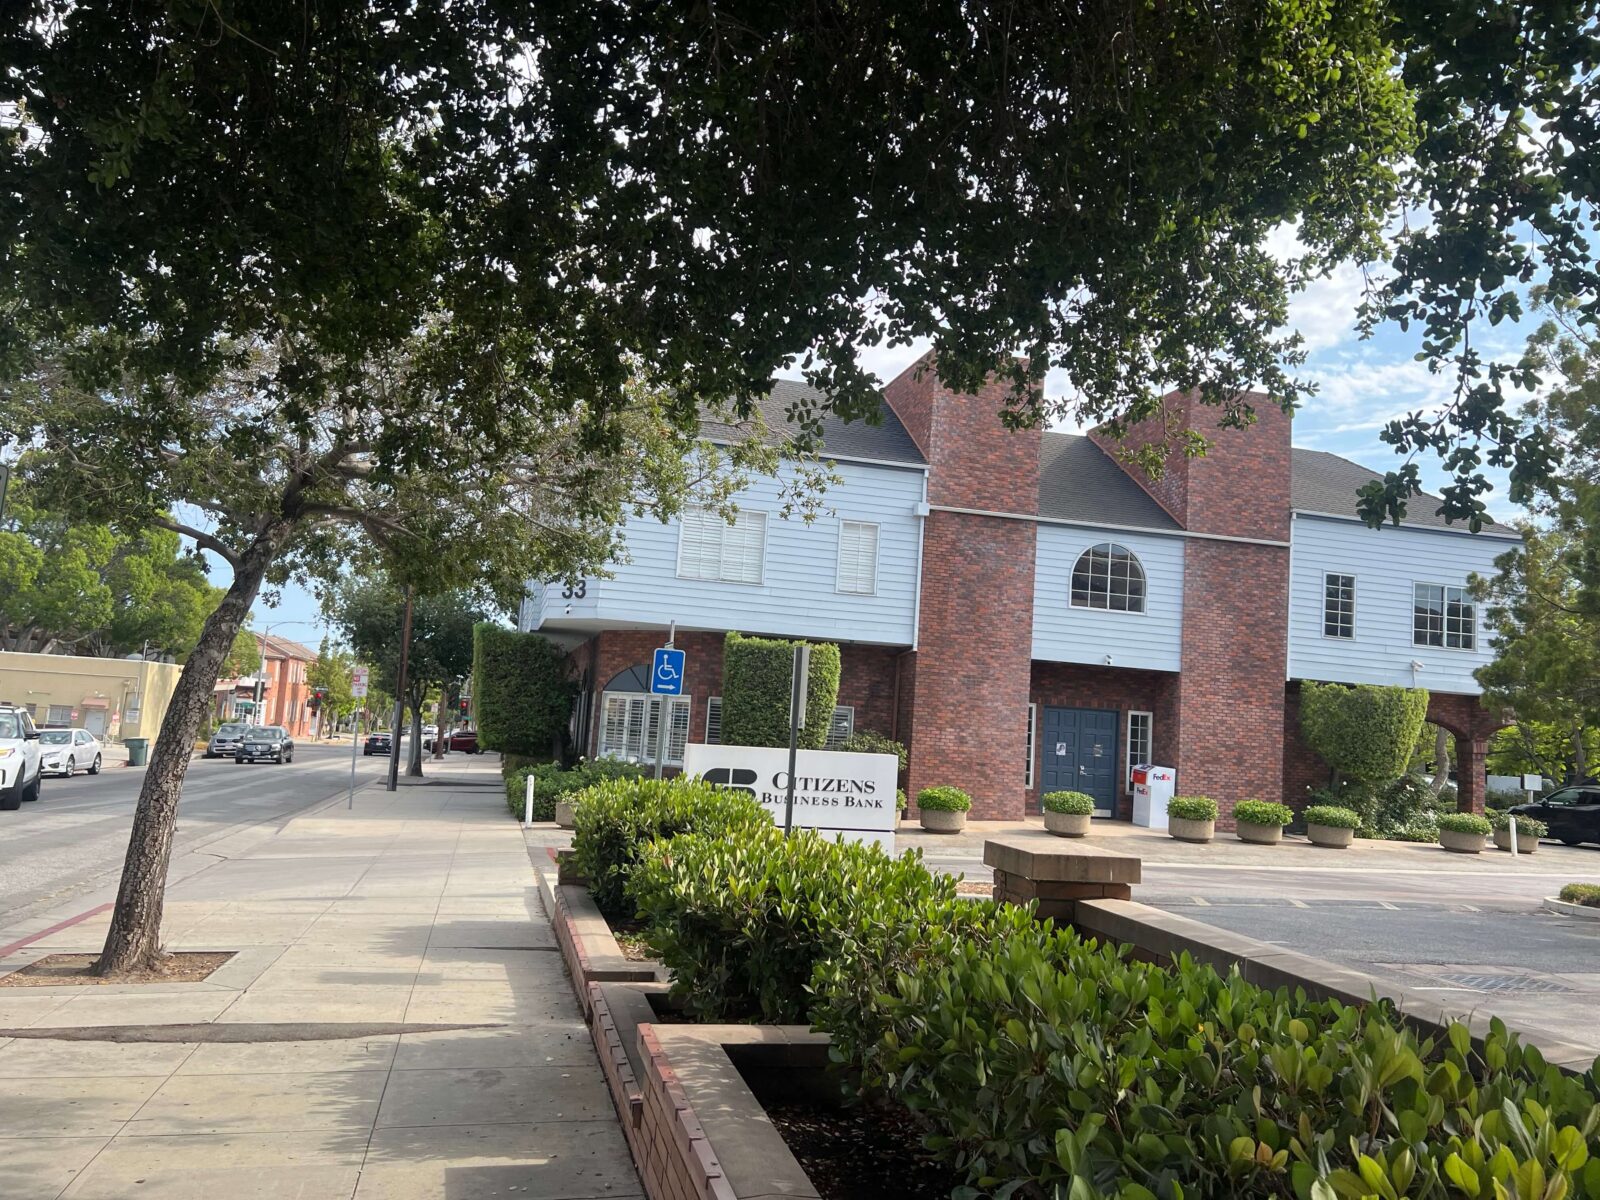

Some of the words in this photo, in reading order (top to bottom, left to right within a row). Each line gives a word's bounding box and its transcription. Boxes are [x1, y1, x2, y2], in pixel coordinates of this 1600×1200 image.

[561, 579, 587, 600] 33
[772, 771, 876, 794] CITIZENS
[1152, 773, 1172, 781] FedEx
[844, 796, 883, 809] BANK
